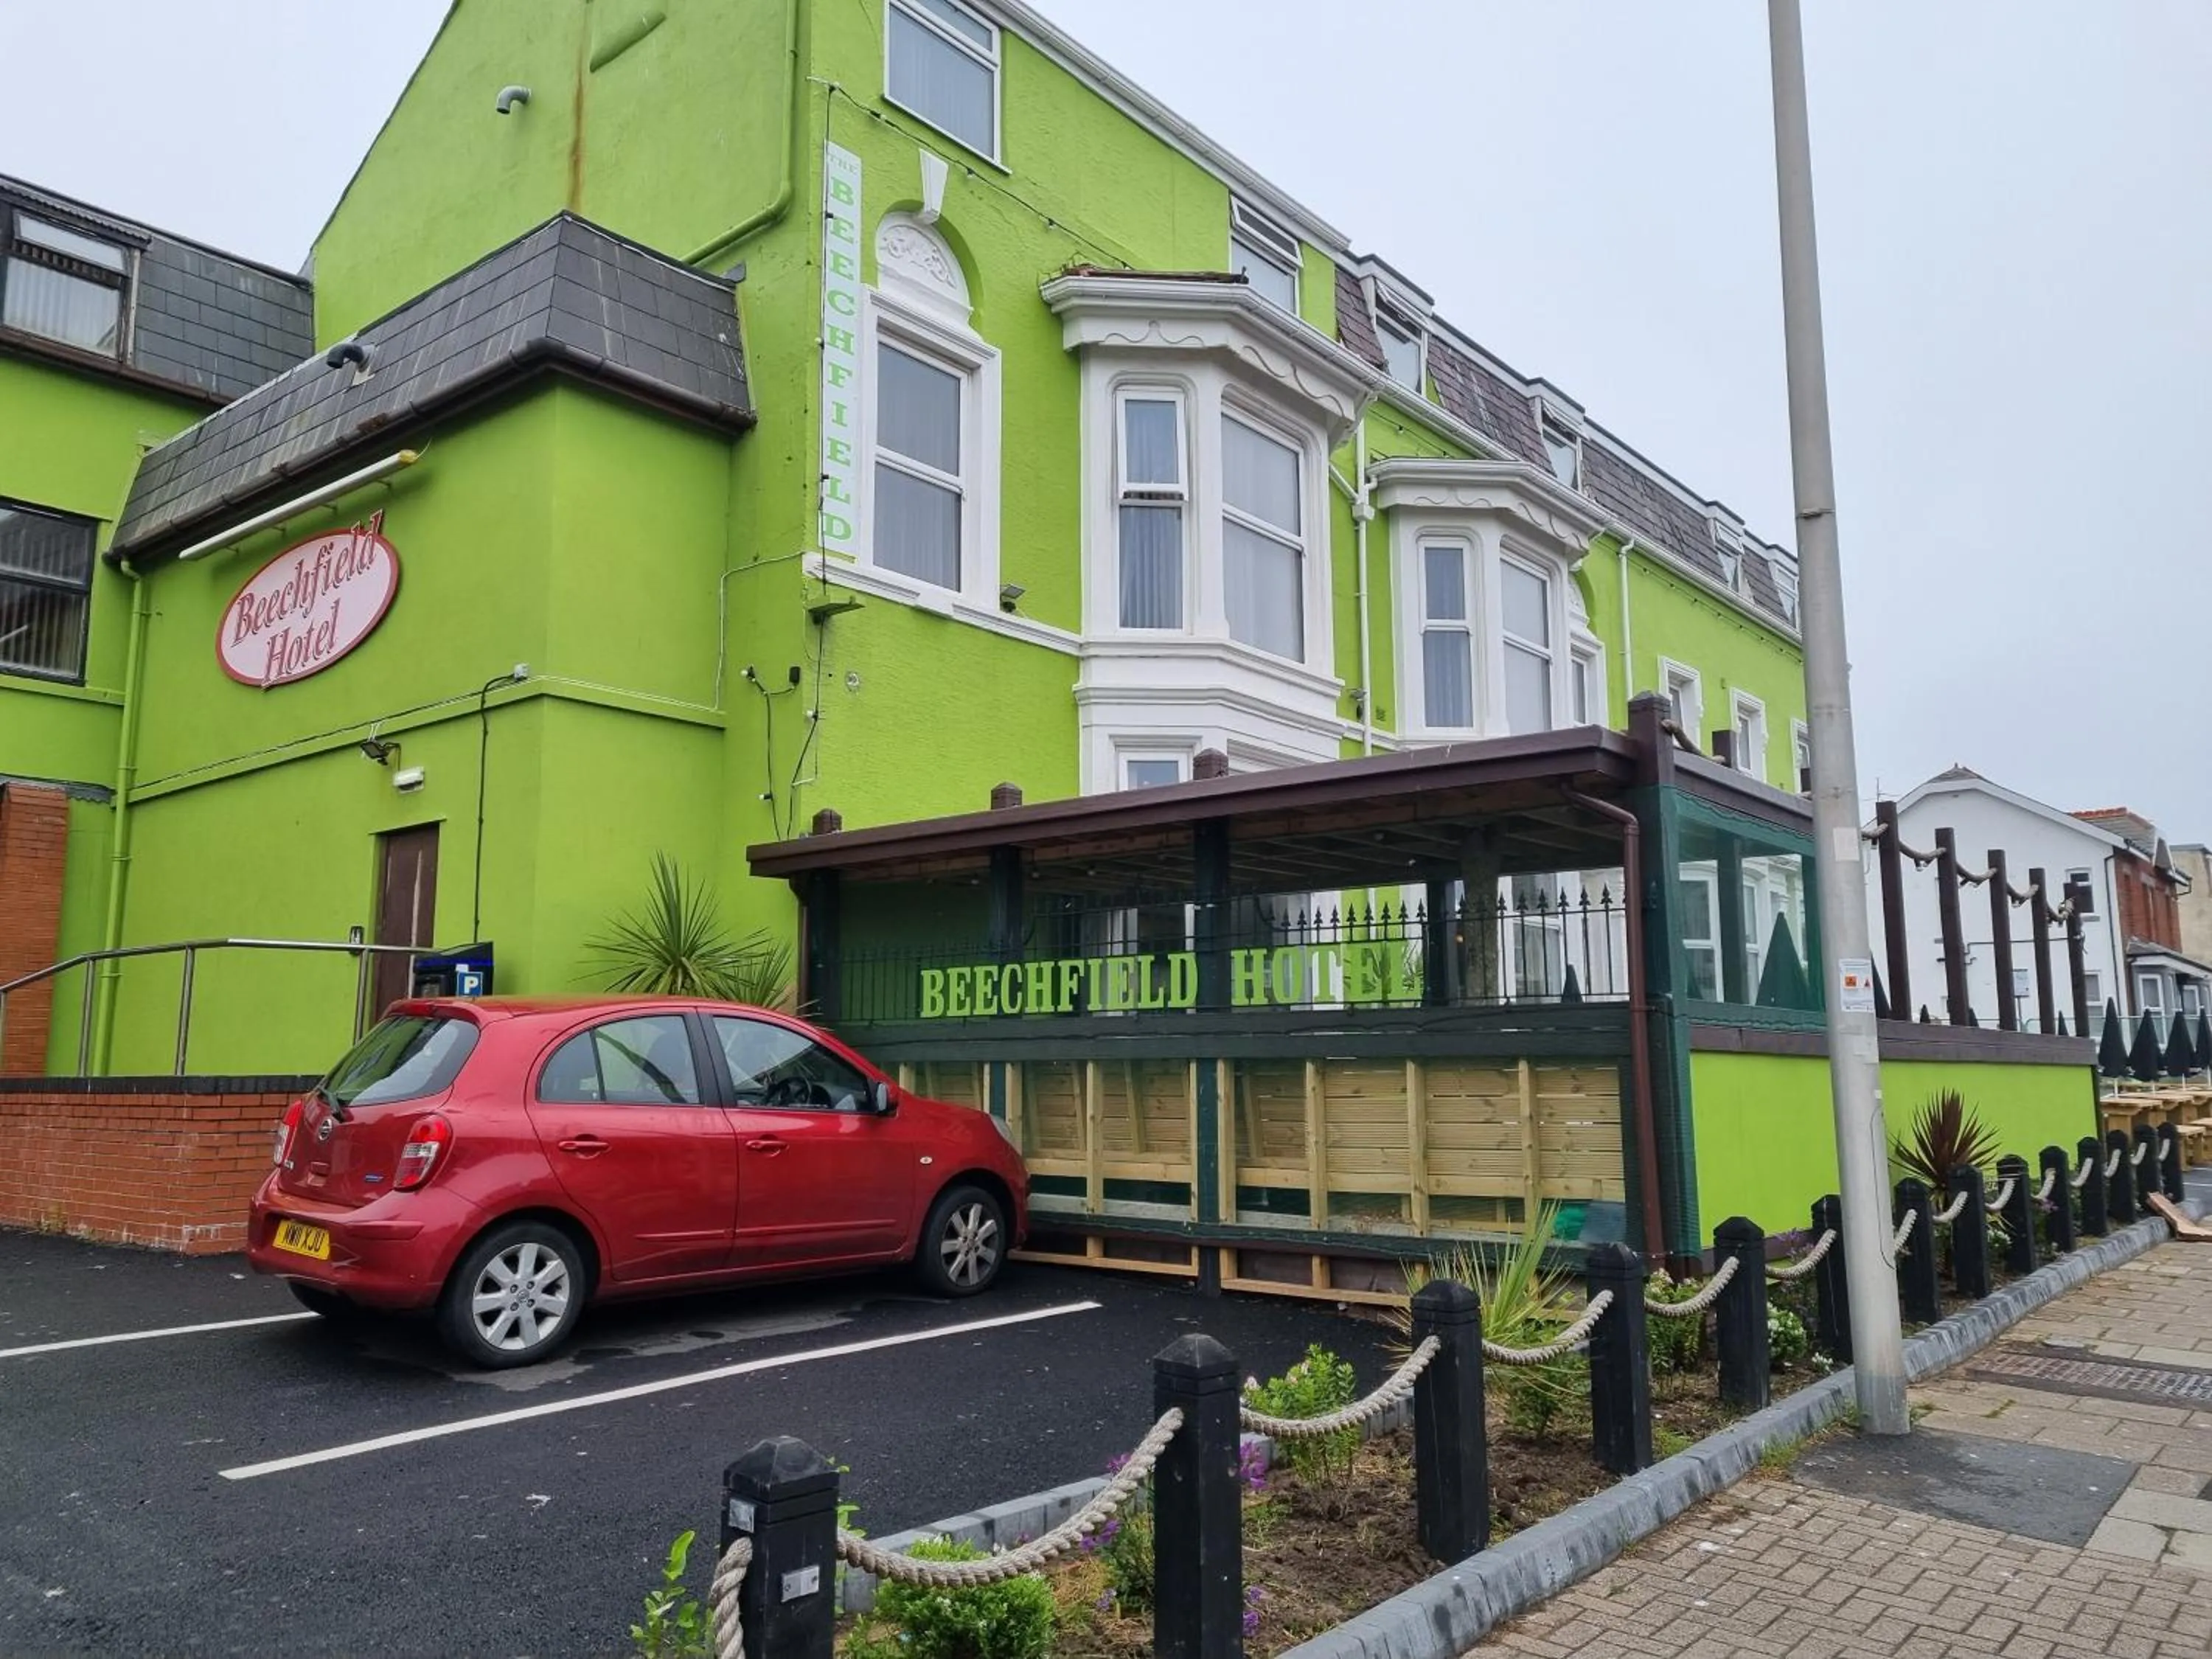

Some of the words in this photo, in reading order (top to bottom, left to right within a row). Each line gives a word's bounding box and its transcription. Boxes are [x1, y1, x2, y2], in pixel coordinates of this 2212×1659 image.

[824, 175, 855, 542] BEECHFIELD
[231, 508, 383, 648] Beechfield
[261, 598, 341, 692] Hotel
[464, 975, 479, 994] P
[920, 952, 1199, 1018] BEECHFIELD
[1231, 940, 1424, 1006] HOTEL
